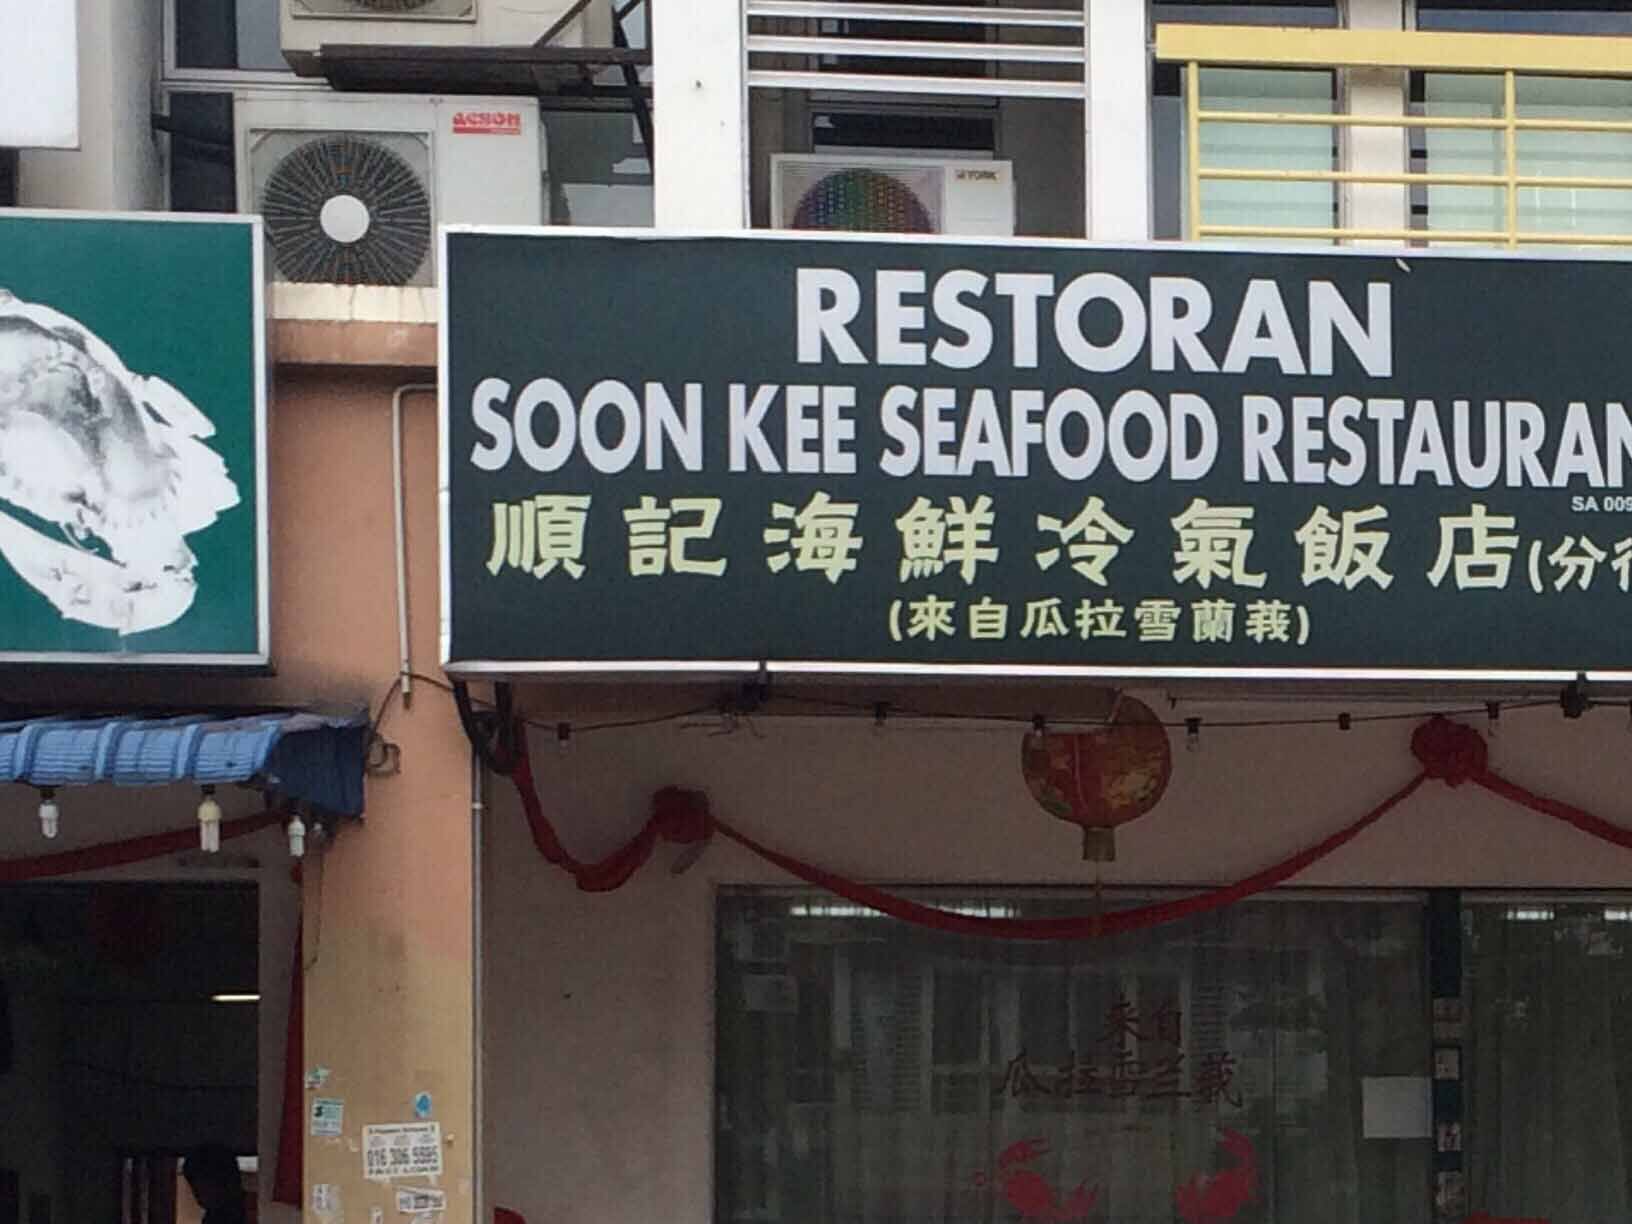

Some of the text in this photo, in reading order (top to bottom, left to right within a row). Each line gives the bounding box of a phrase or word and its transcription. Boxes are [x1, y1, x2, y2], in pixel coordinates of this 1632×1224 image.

[796, 267, 1393, 377] RESTORAN
[470, 378, 703, 474] SOON
[728, 383, 857, 474] KEE
[879, 384, 1219, 482] SEAFOOD
[1571, 495, 1600, 512] SA
